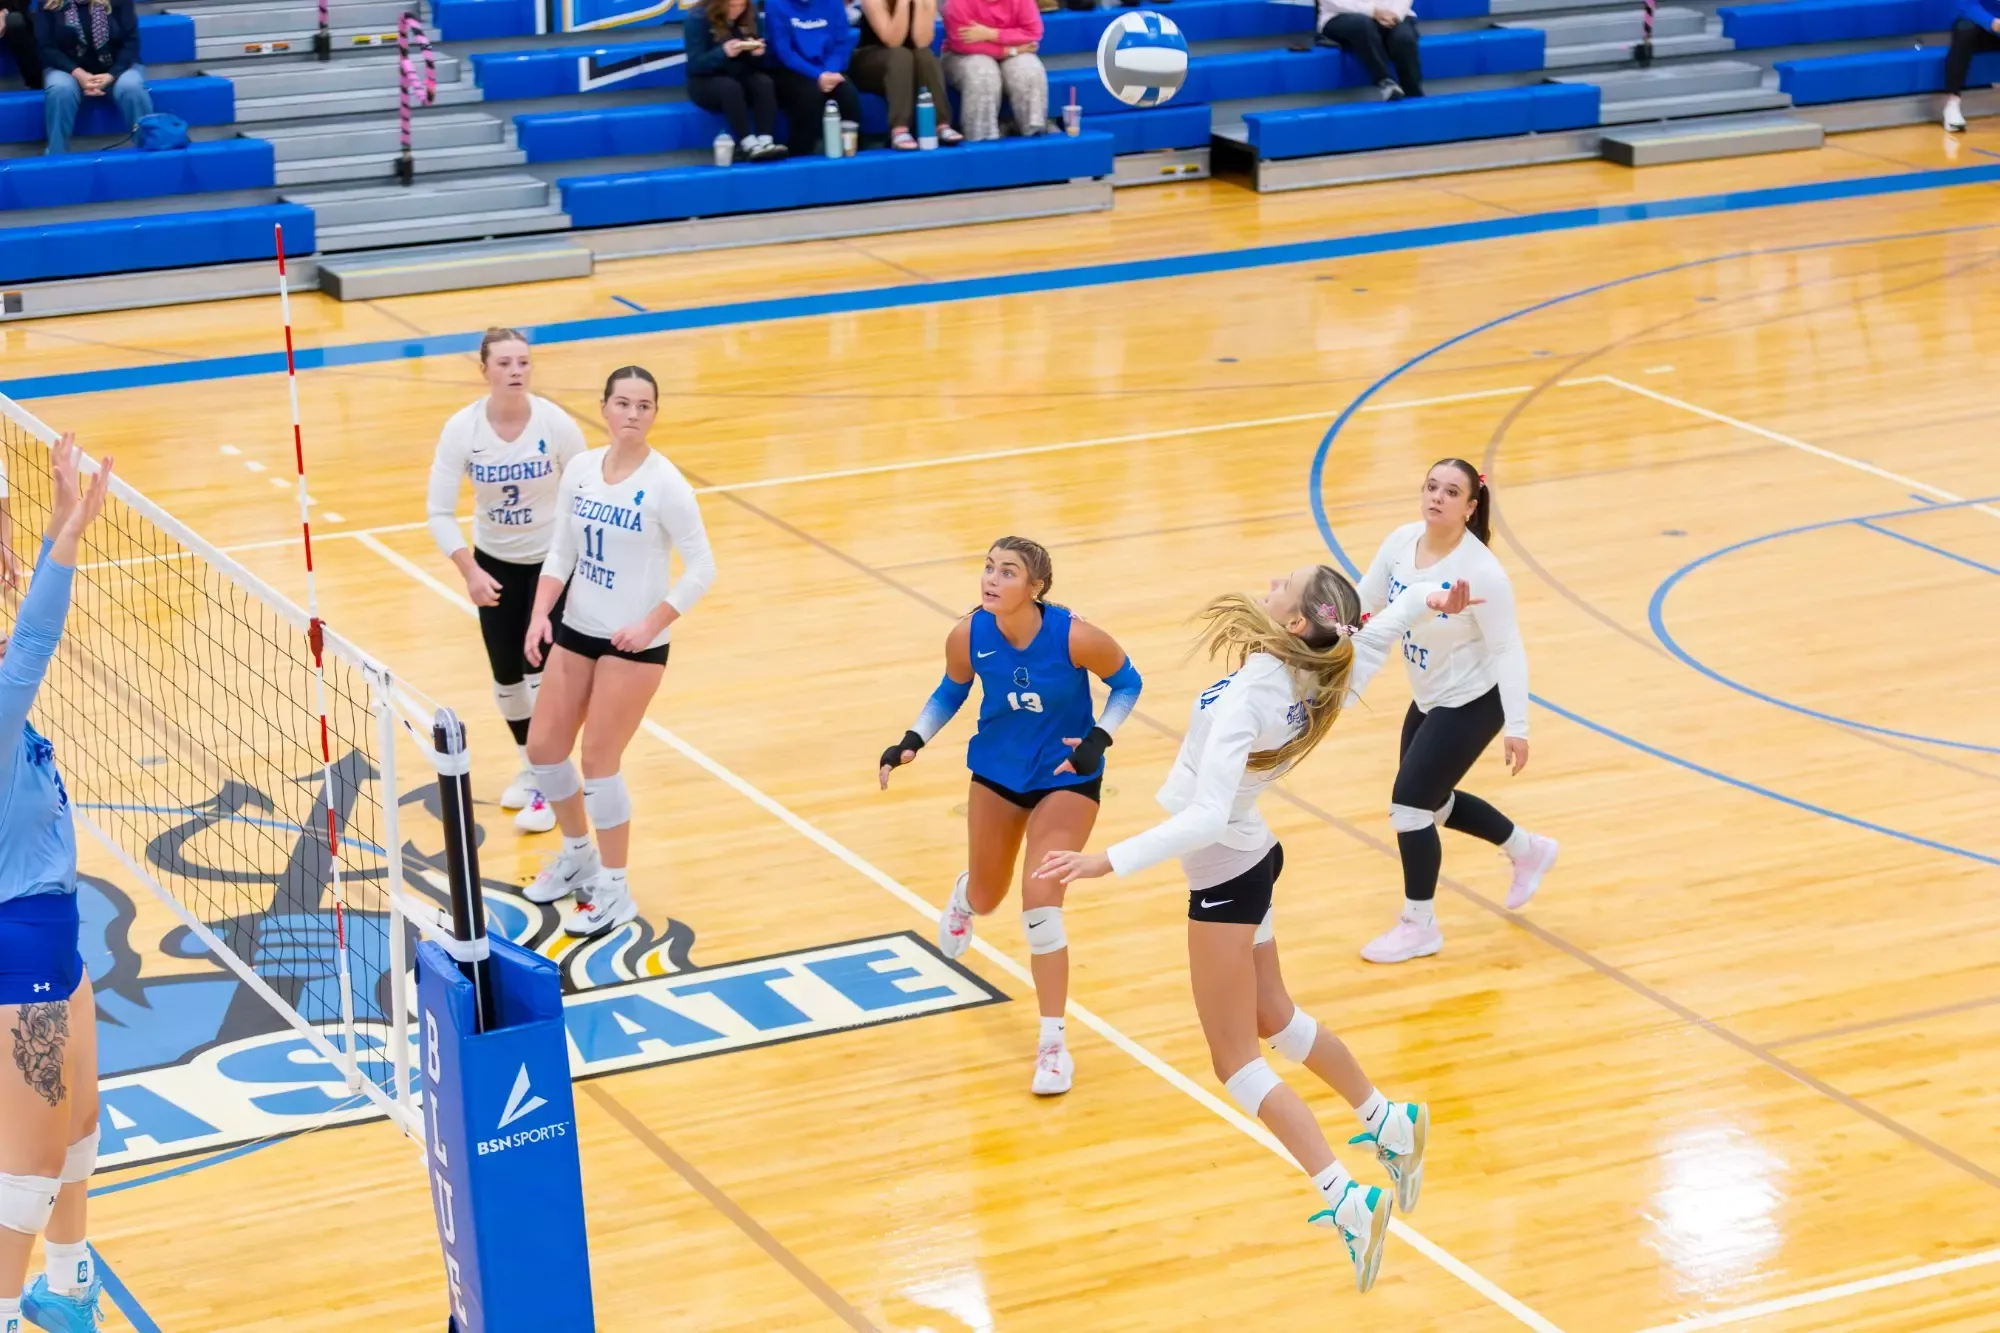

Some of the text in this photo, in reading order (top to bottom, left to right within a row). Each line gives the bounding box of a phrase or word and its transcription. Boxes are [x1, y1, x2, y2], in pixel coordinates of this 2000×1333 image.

[502, 485, 520, 507] 3
[487, 508, 532, 525] STATE
[584, 524, 604, 562] 11
[1007, 691, 1044, 713] 13
[425, 1008, 468, 1328] BLUE
